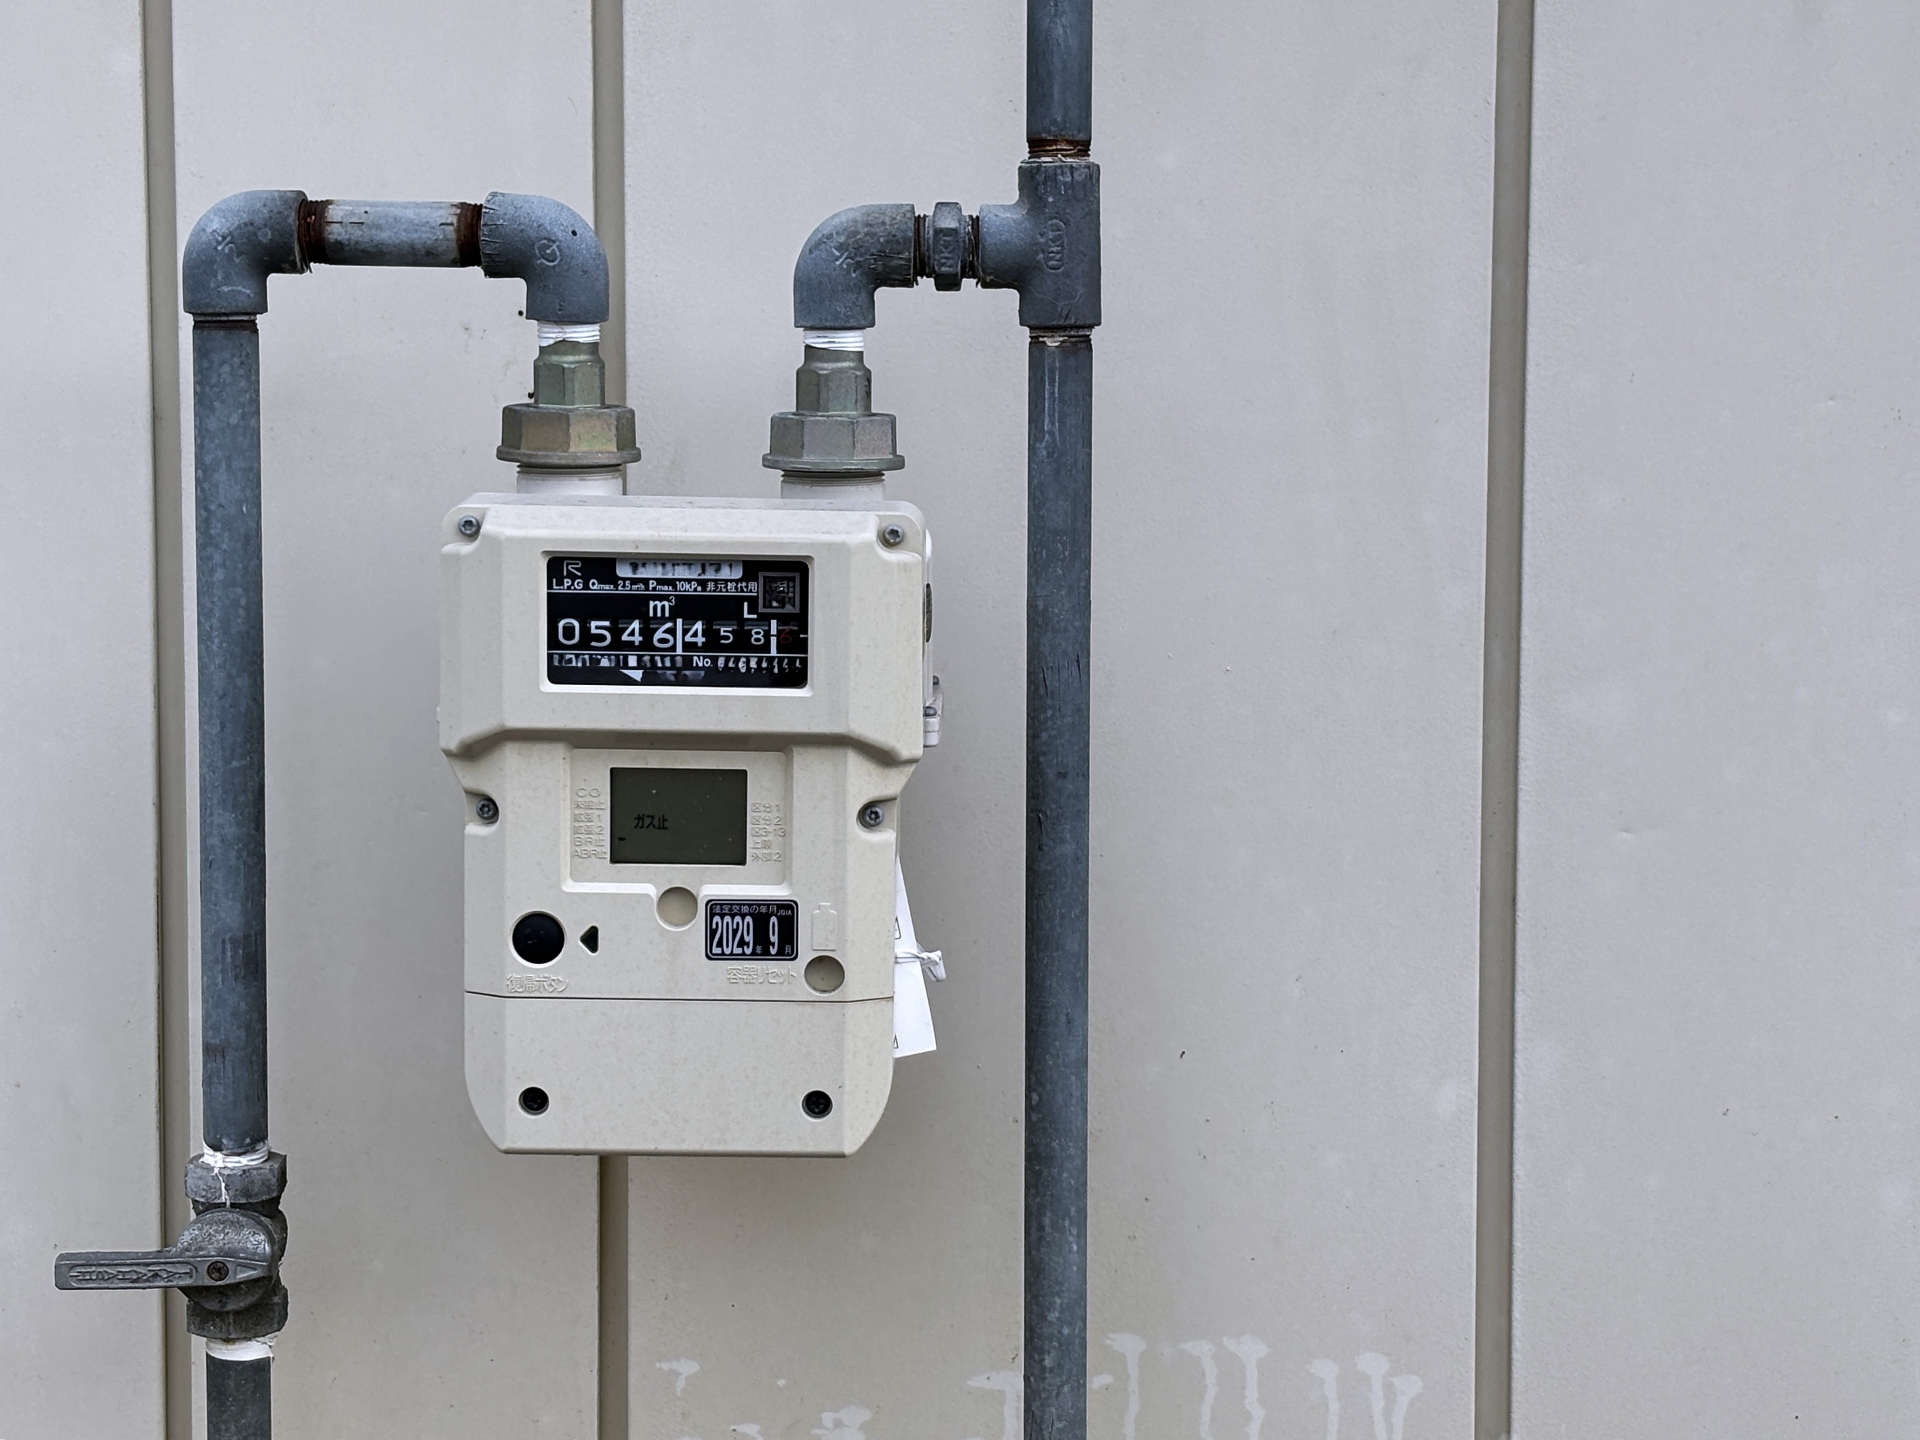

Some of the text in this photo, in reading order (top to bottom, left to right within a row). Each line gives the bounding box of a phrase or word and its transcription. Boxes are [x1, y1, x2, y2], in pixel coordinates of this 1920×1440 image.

[552, 578, 583, 590] L.P.G
[743, 601, 758, 619] L
[692, 655, 714, 668] No.
[576, 787, 602, 798] CO
[633, 813, 669, 830] ガス止
[712, 904, 777, 915] 法定交換の年月
[769, 915, 779, 955] 9
[726, 965, 797, 984] 容器リセット
